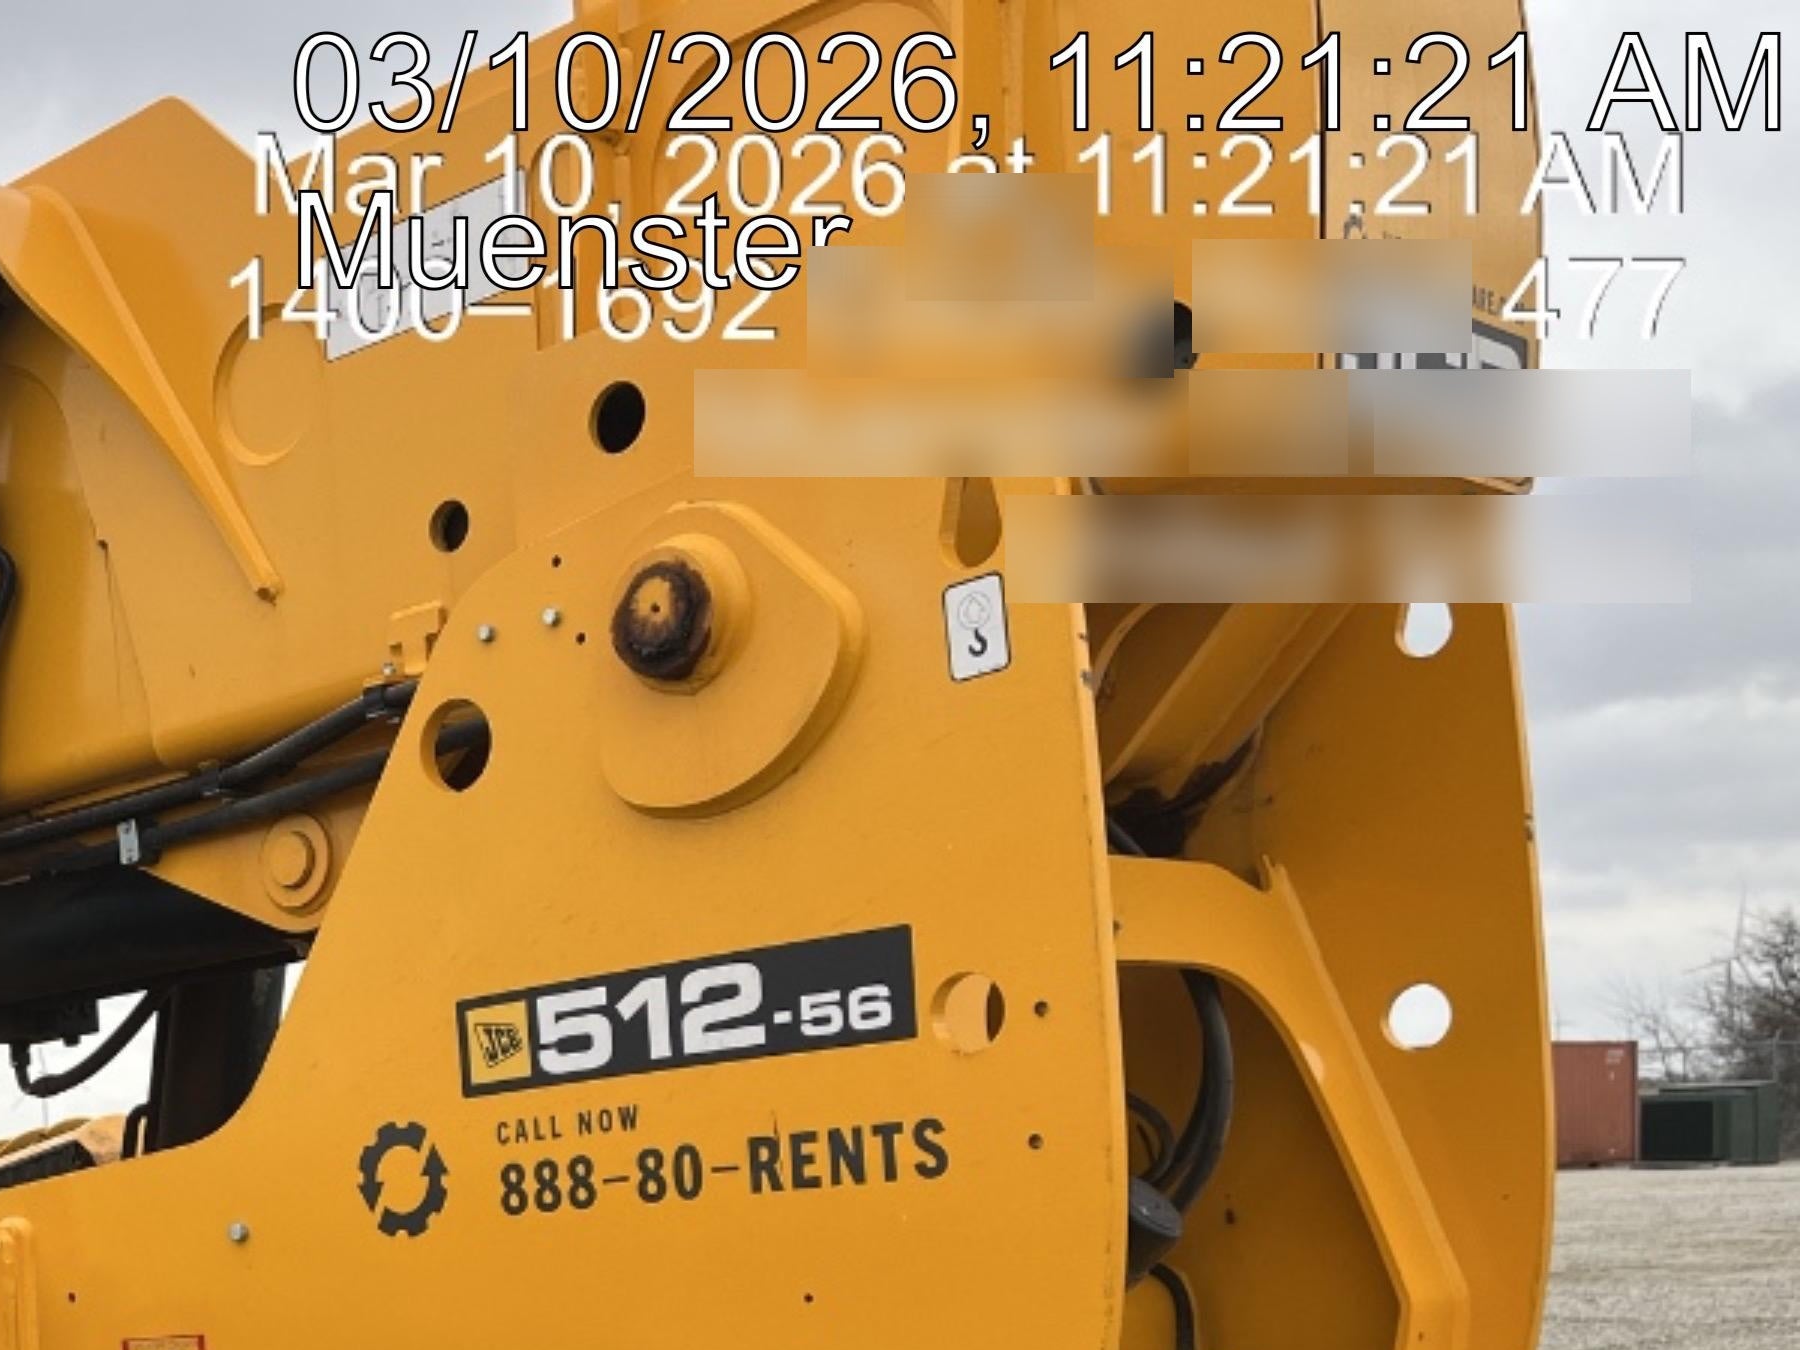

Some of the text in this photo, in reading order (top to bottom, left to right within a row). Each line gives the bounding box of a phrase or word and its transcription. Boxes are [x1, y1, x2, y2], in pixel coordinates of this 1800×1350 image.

[479, 1026, 522, 1063] JCB
[535, 962, 893, 1075] 512-56
[496, 1104, 641, 1145] CALL NOW
[499, 1116, 951, 1217] 888-80-RENTS
